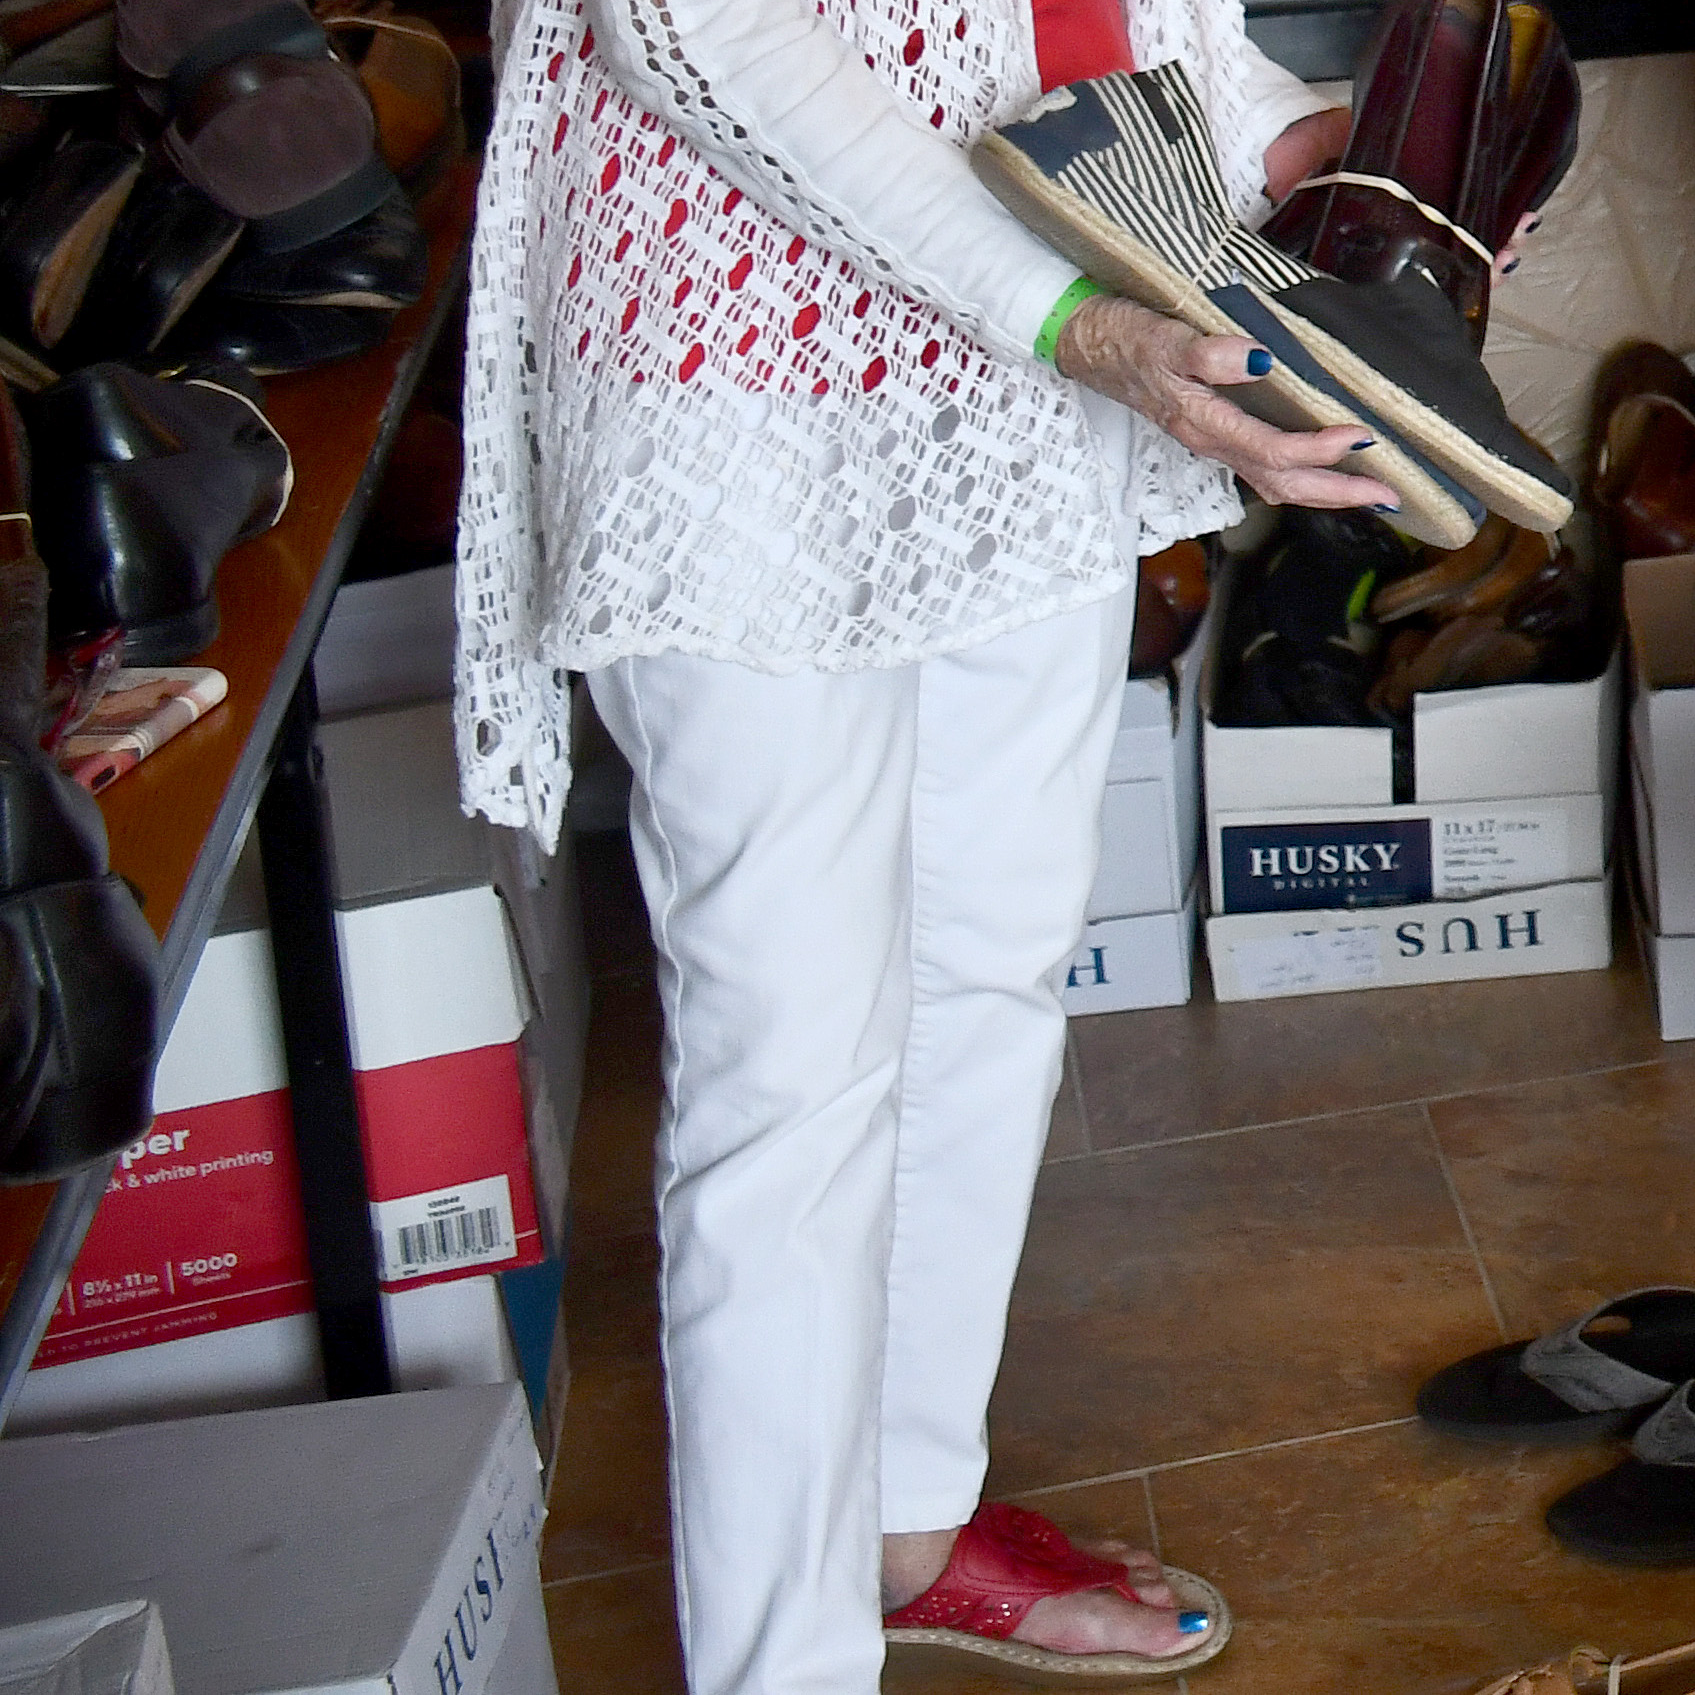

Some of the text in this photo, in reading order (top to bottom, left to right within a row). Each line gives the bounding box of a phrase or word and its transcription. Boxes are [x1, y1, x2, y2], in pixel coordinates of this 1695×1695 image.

[1250, 842, 1401, 877] HUSKY
[126, 1173, 141, 1189] &
[144, 1164, 197, 1185] white
[201, 1150, 275, 1178] printing
[180, 1252, 238, 1277] 5000
